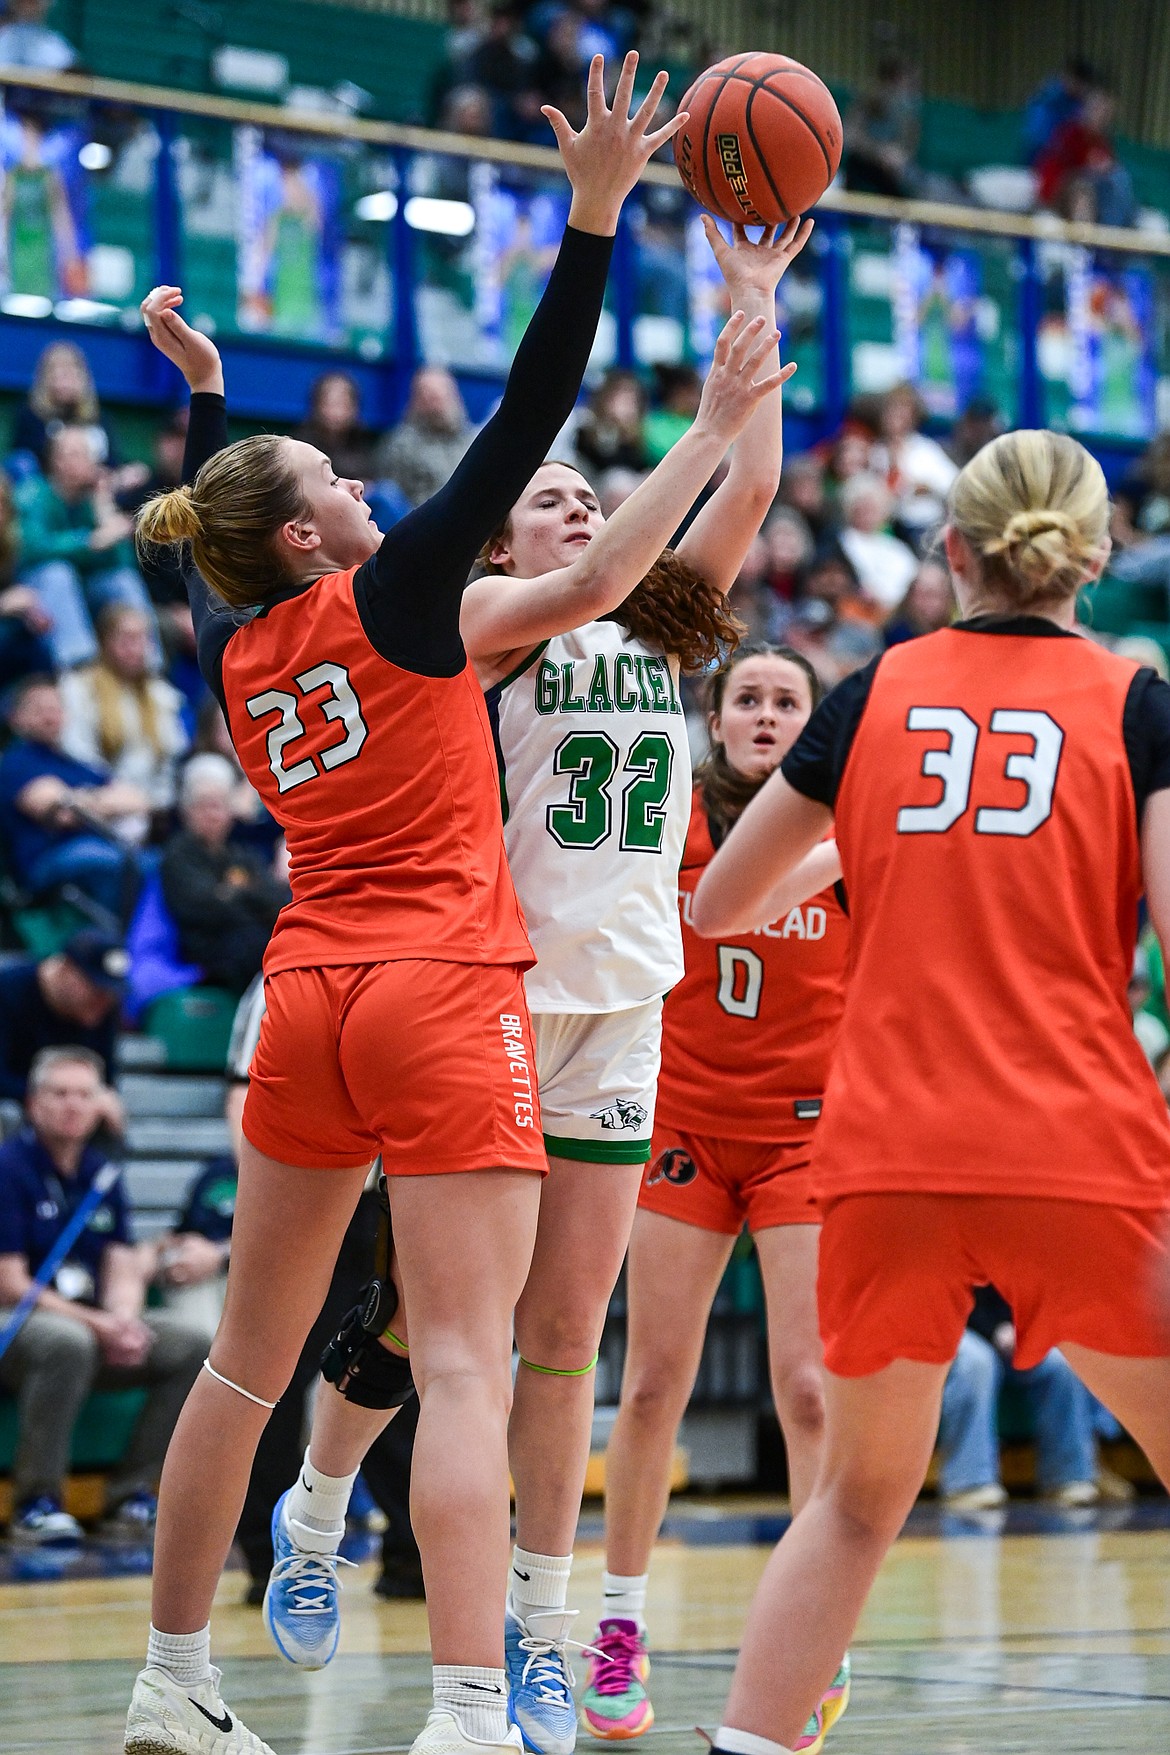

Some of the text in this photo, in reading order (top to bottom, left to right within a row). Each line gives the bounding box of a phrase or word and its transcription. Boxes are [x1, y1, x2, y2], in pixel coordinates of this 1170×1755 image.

[245, 660, 370, 795] 23
[896, 705, 1066, 838] 33
[546, 731, 675, 854] 32
[717, 944, 764, 1020] 0
[500, 1013, 534, 1128] BRAVETTES
